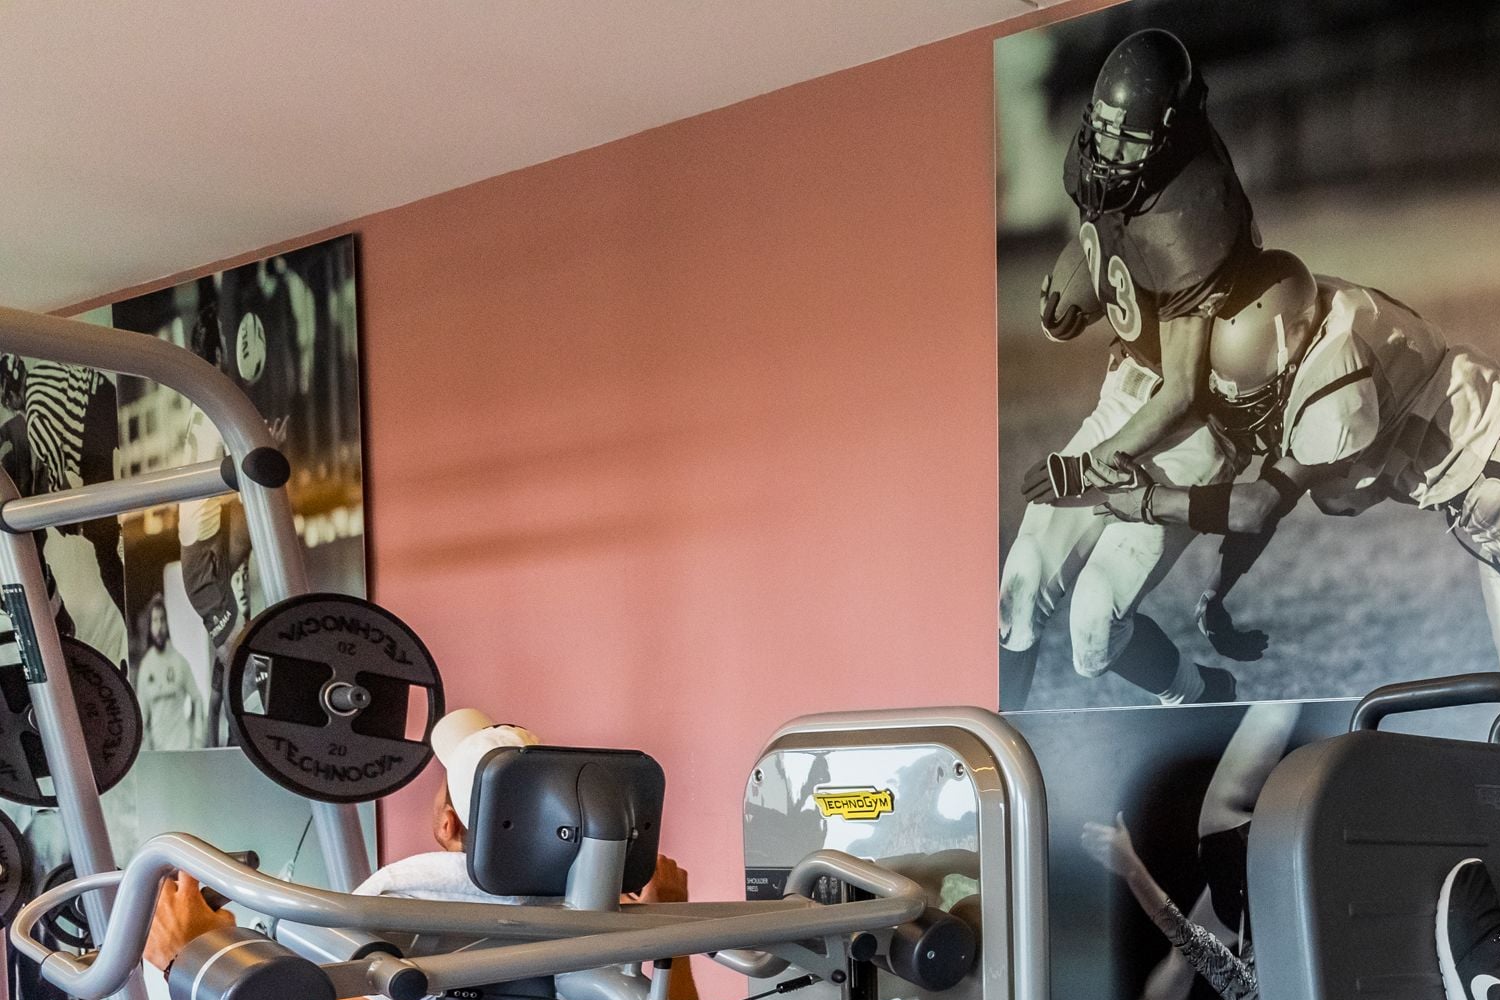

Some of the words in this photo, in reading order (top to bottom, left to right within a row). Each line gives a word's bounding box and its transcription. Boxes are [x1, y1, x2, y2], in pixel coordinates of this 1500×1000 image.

[278, 615, 414, 666] TECHNOGYM
[265, 734, 404, 783] TECHNOGYM
[327, 742, 347, 756] 20
[816, 795, 889, 814] TECHNOGYM
